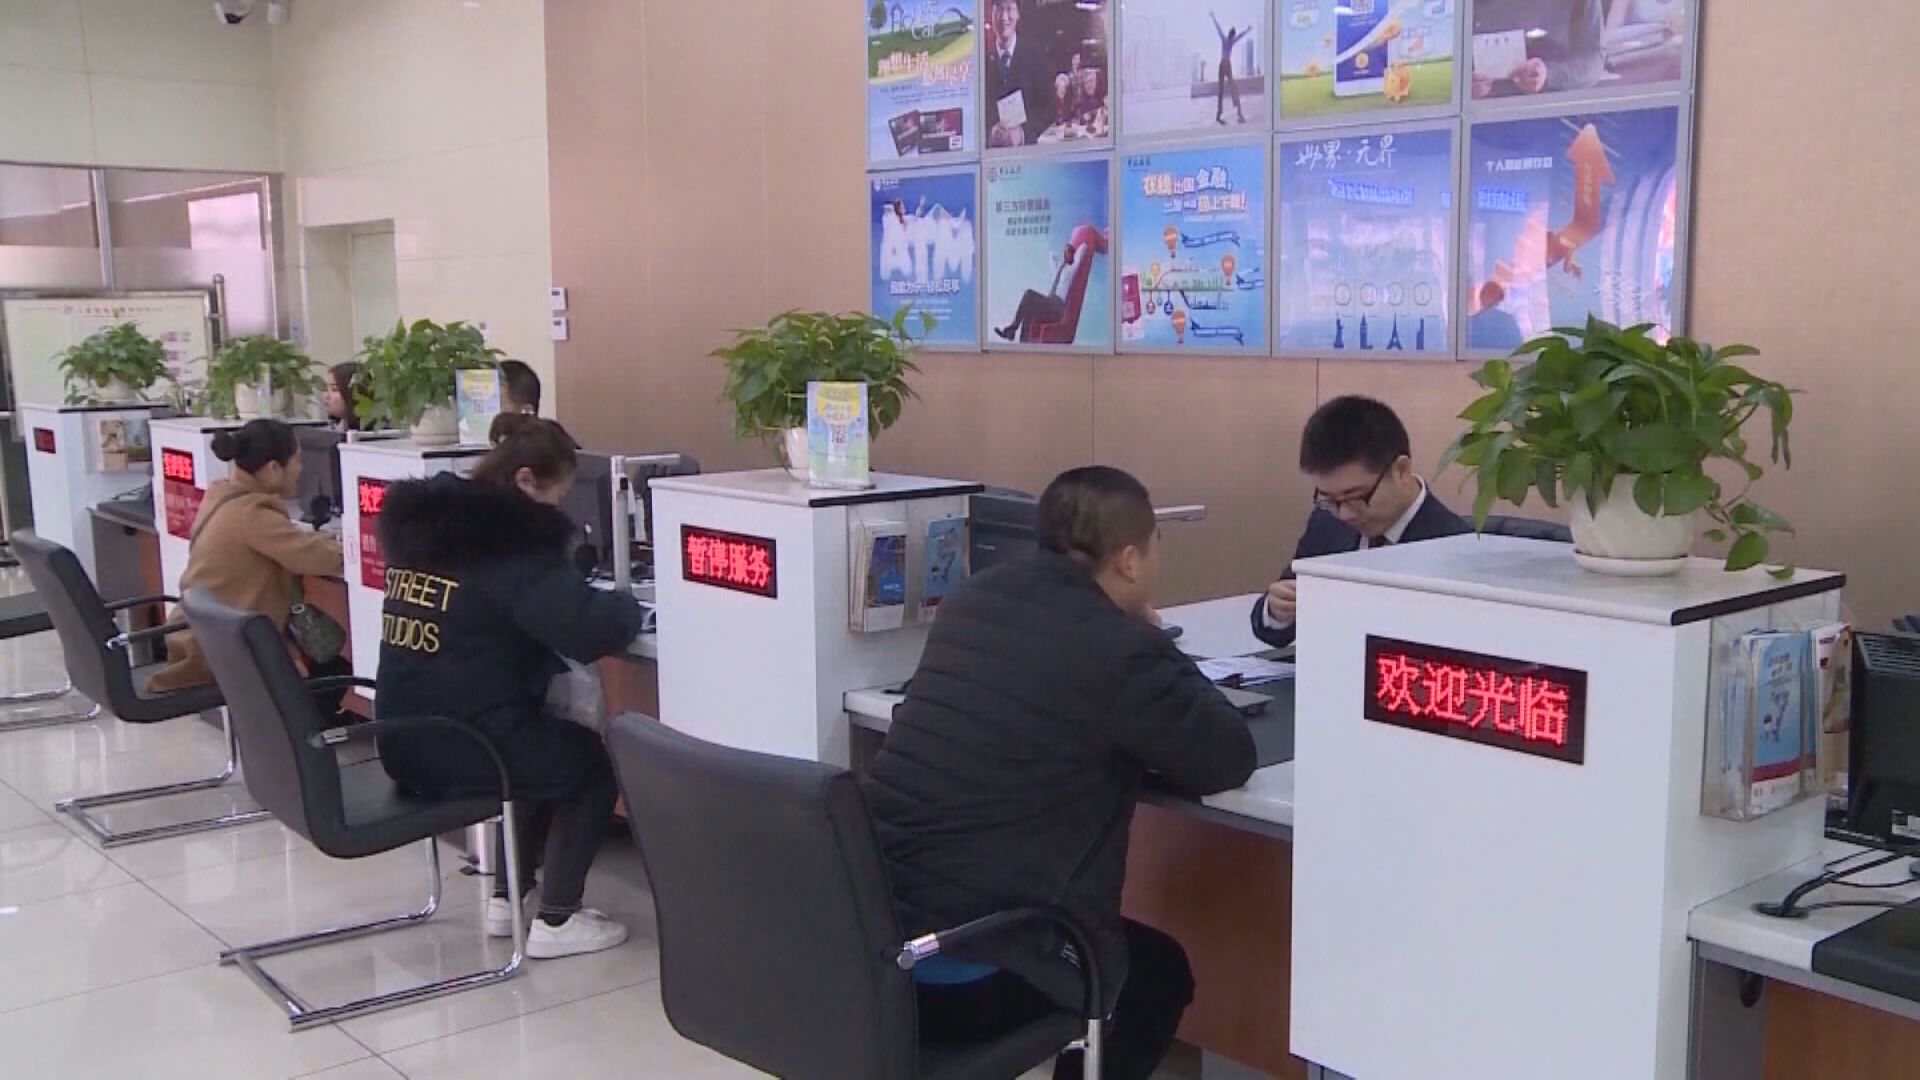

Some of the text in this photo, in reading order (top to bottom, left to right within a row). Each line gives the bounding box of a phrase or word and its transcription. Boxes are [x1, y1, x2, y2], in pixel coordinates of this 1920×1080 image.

[687, 534, 771, 588] 暂停服务
[384, 567, 460, 613] STREET
[383, 613, 441, 653] TUDIOS
[1376, 654, 1569, 746] 欢迎光临
